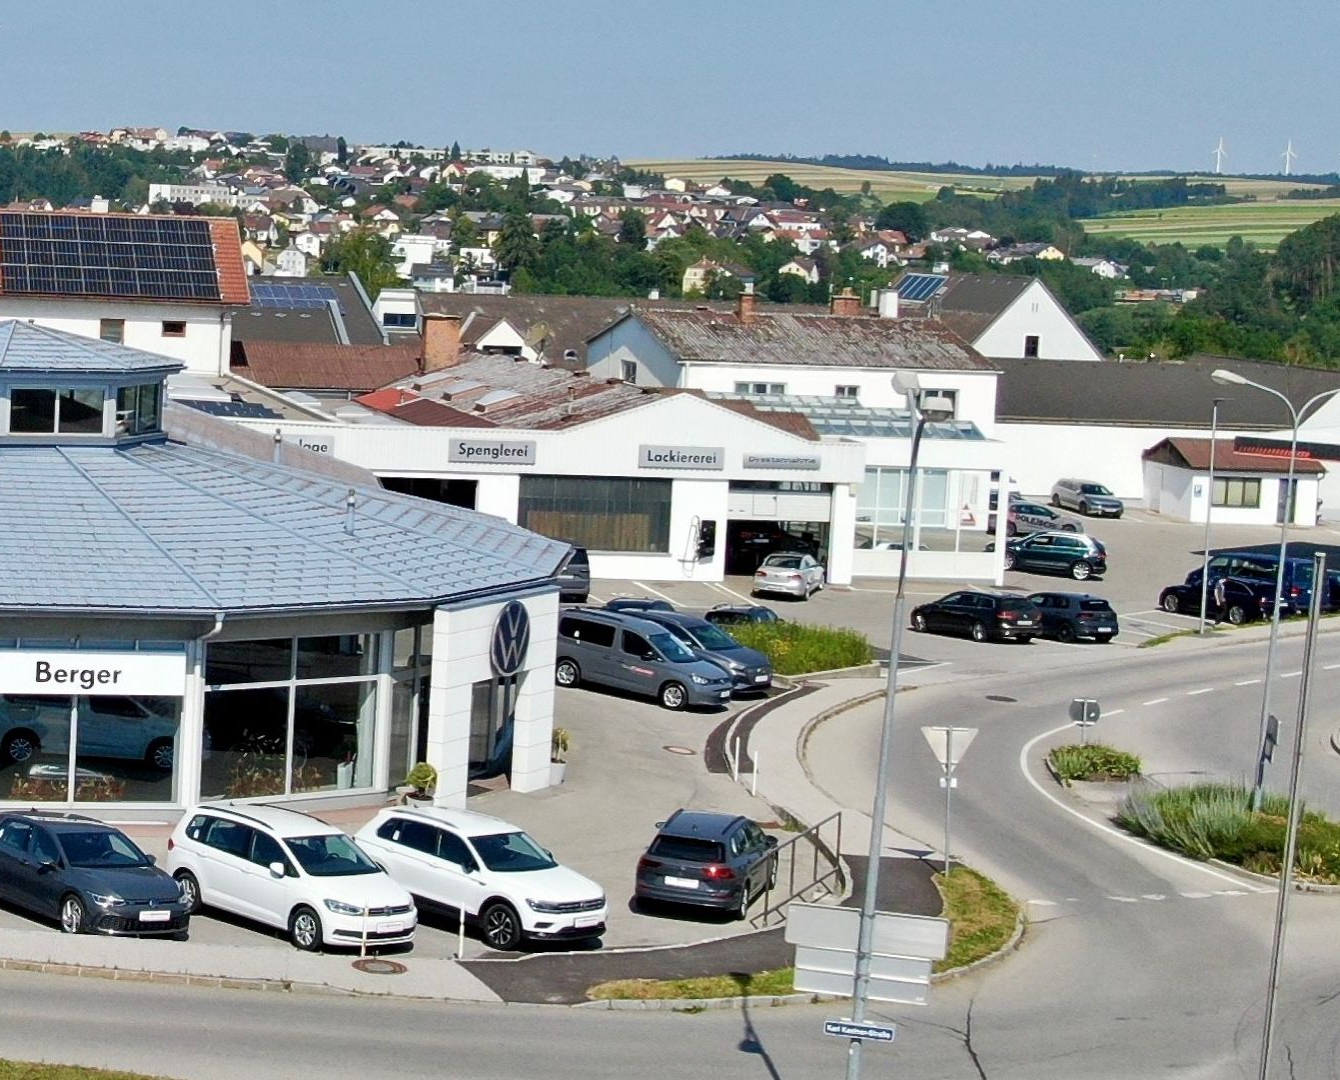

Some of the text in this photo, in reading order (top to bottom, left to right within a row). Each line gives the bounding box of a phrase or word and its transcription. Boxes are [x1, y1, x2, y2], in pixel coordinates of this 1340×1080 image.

[299, 438, 328, 452] lage
[458, 442, 528, 458] Spenglerei
[647, 450, 716, 464] Lackiererei
[748, 455, 817, 465] Direktannahme
[35, 661, 122, 689] Berger
